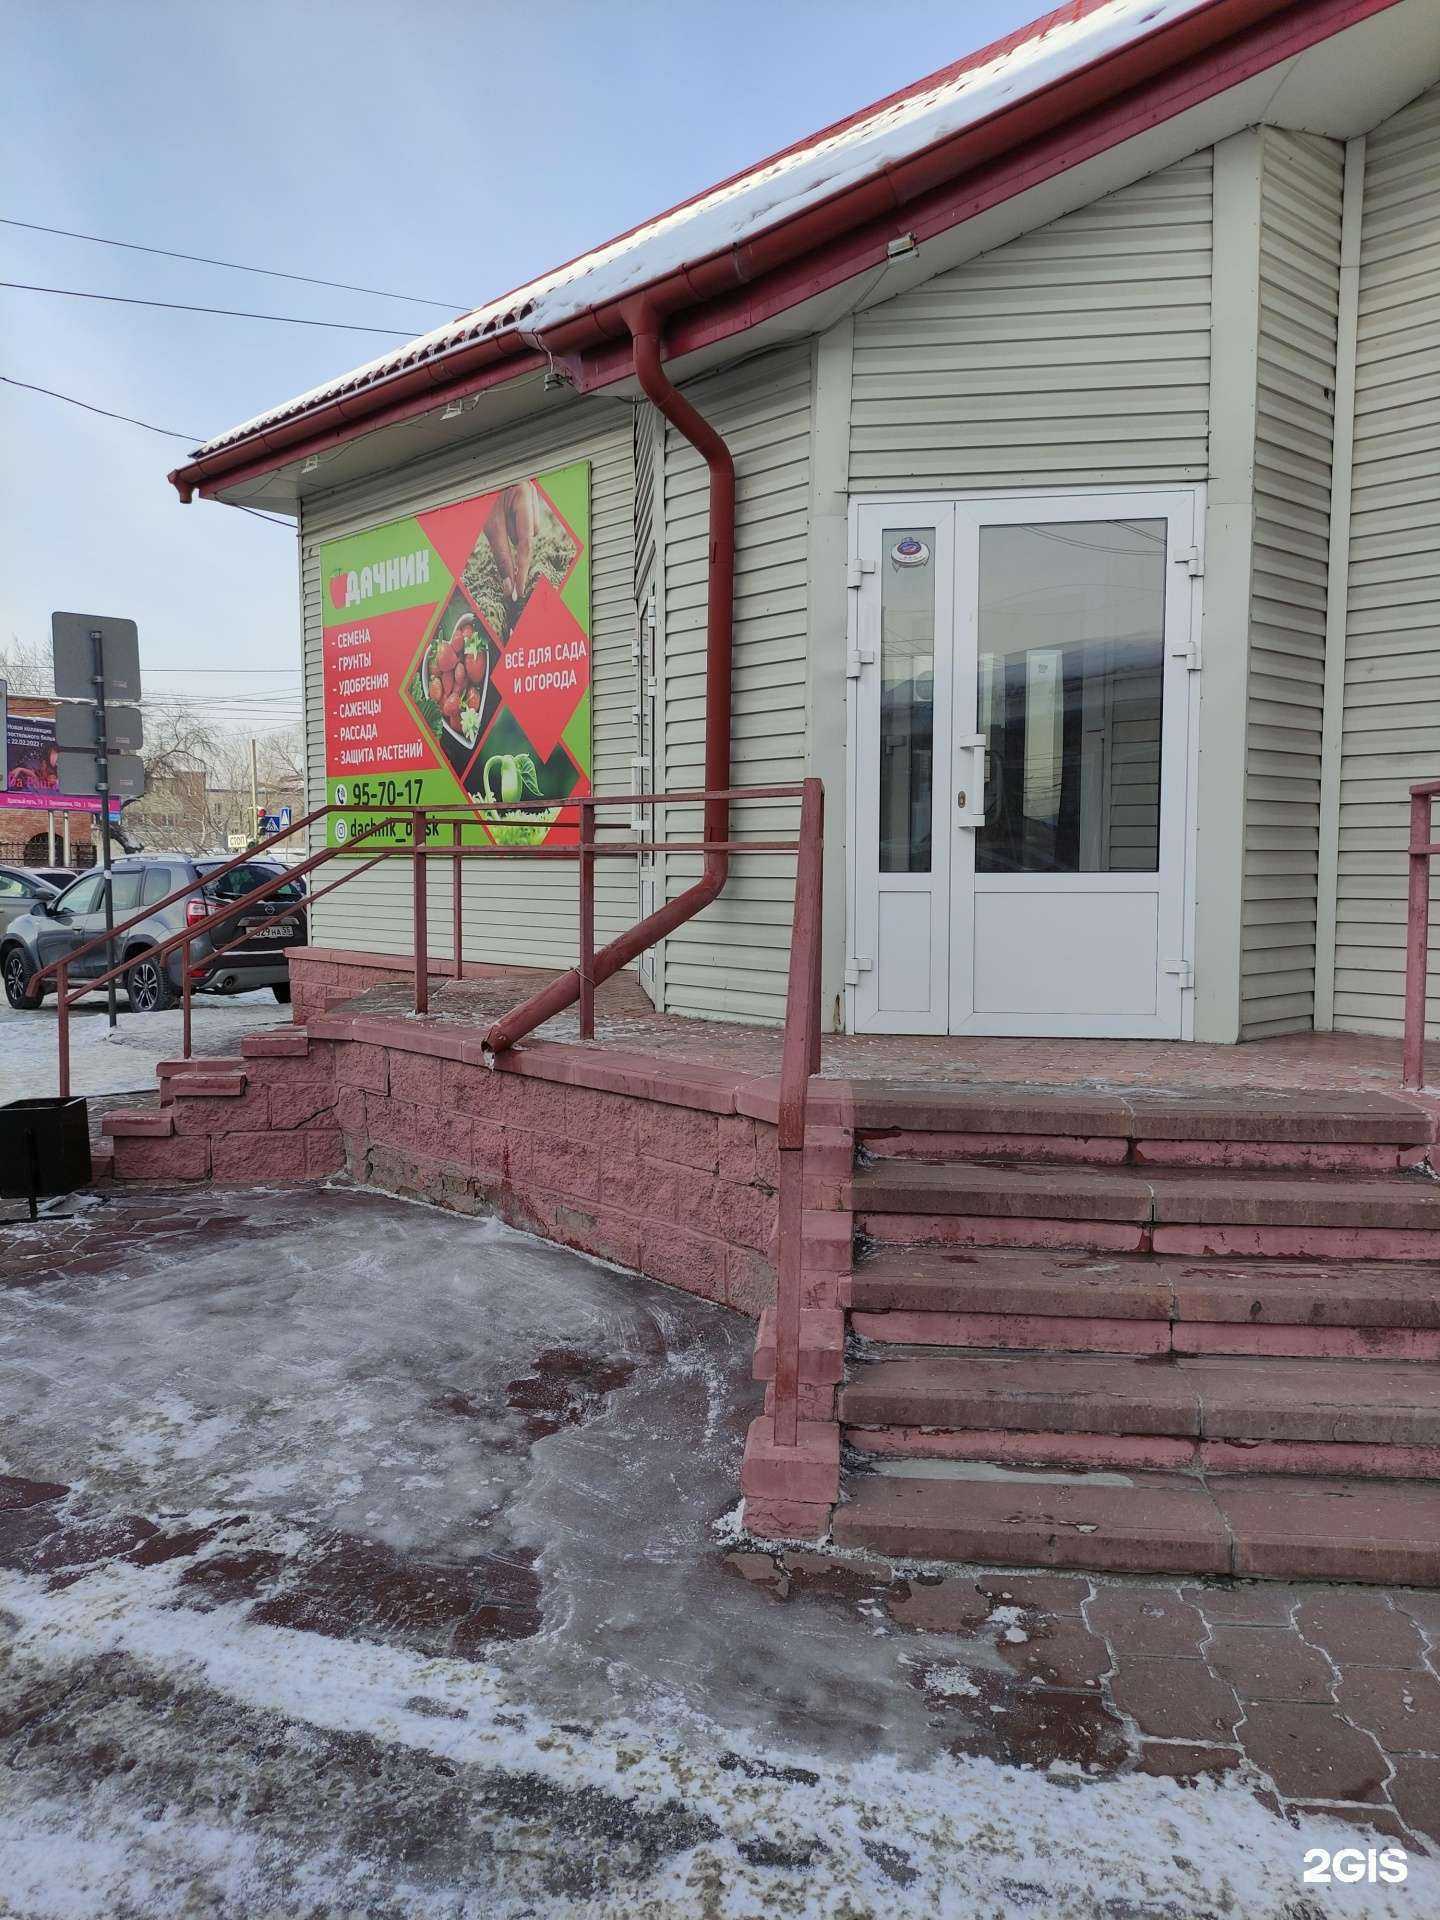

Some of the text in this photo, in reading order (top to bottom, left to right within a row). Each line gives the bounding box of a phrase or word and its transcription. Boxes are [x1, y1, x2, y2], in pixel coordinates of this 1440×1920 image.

[345, 549, 430, 608] ДАЧНИК
[338, 628, 371, 649] СЕМЕНА
[338, 652, 372, 671] ГРУНТЫ
[505, 640, 586, 669] ВСЁ ДЛЯ САДА
[339, 672, 389, 696] УДОБРЕНИЯ
[513, 669, 577, 694] И ОГОРОДА
[340, 699, 382, 718] САЖЕНЦЫ
[340, 723, 378, 741] РАССАДА
[340, 739, 423, 765] ЗАЩИТА РАСТЕНИЙ
[353, 779, 423, 806] 95-70-17
[350, 816, 440, 843] dachnik_osk
